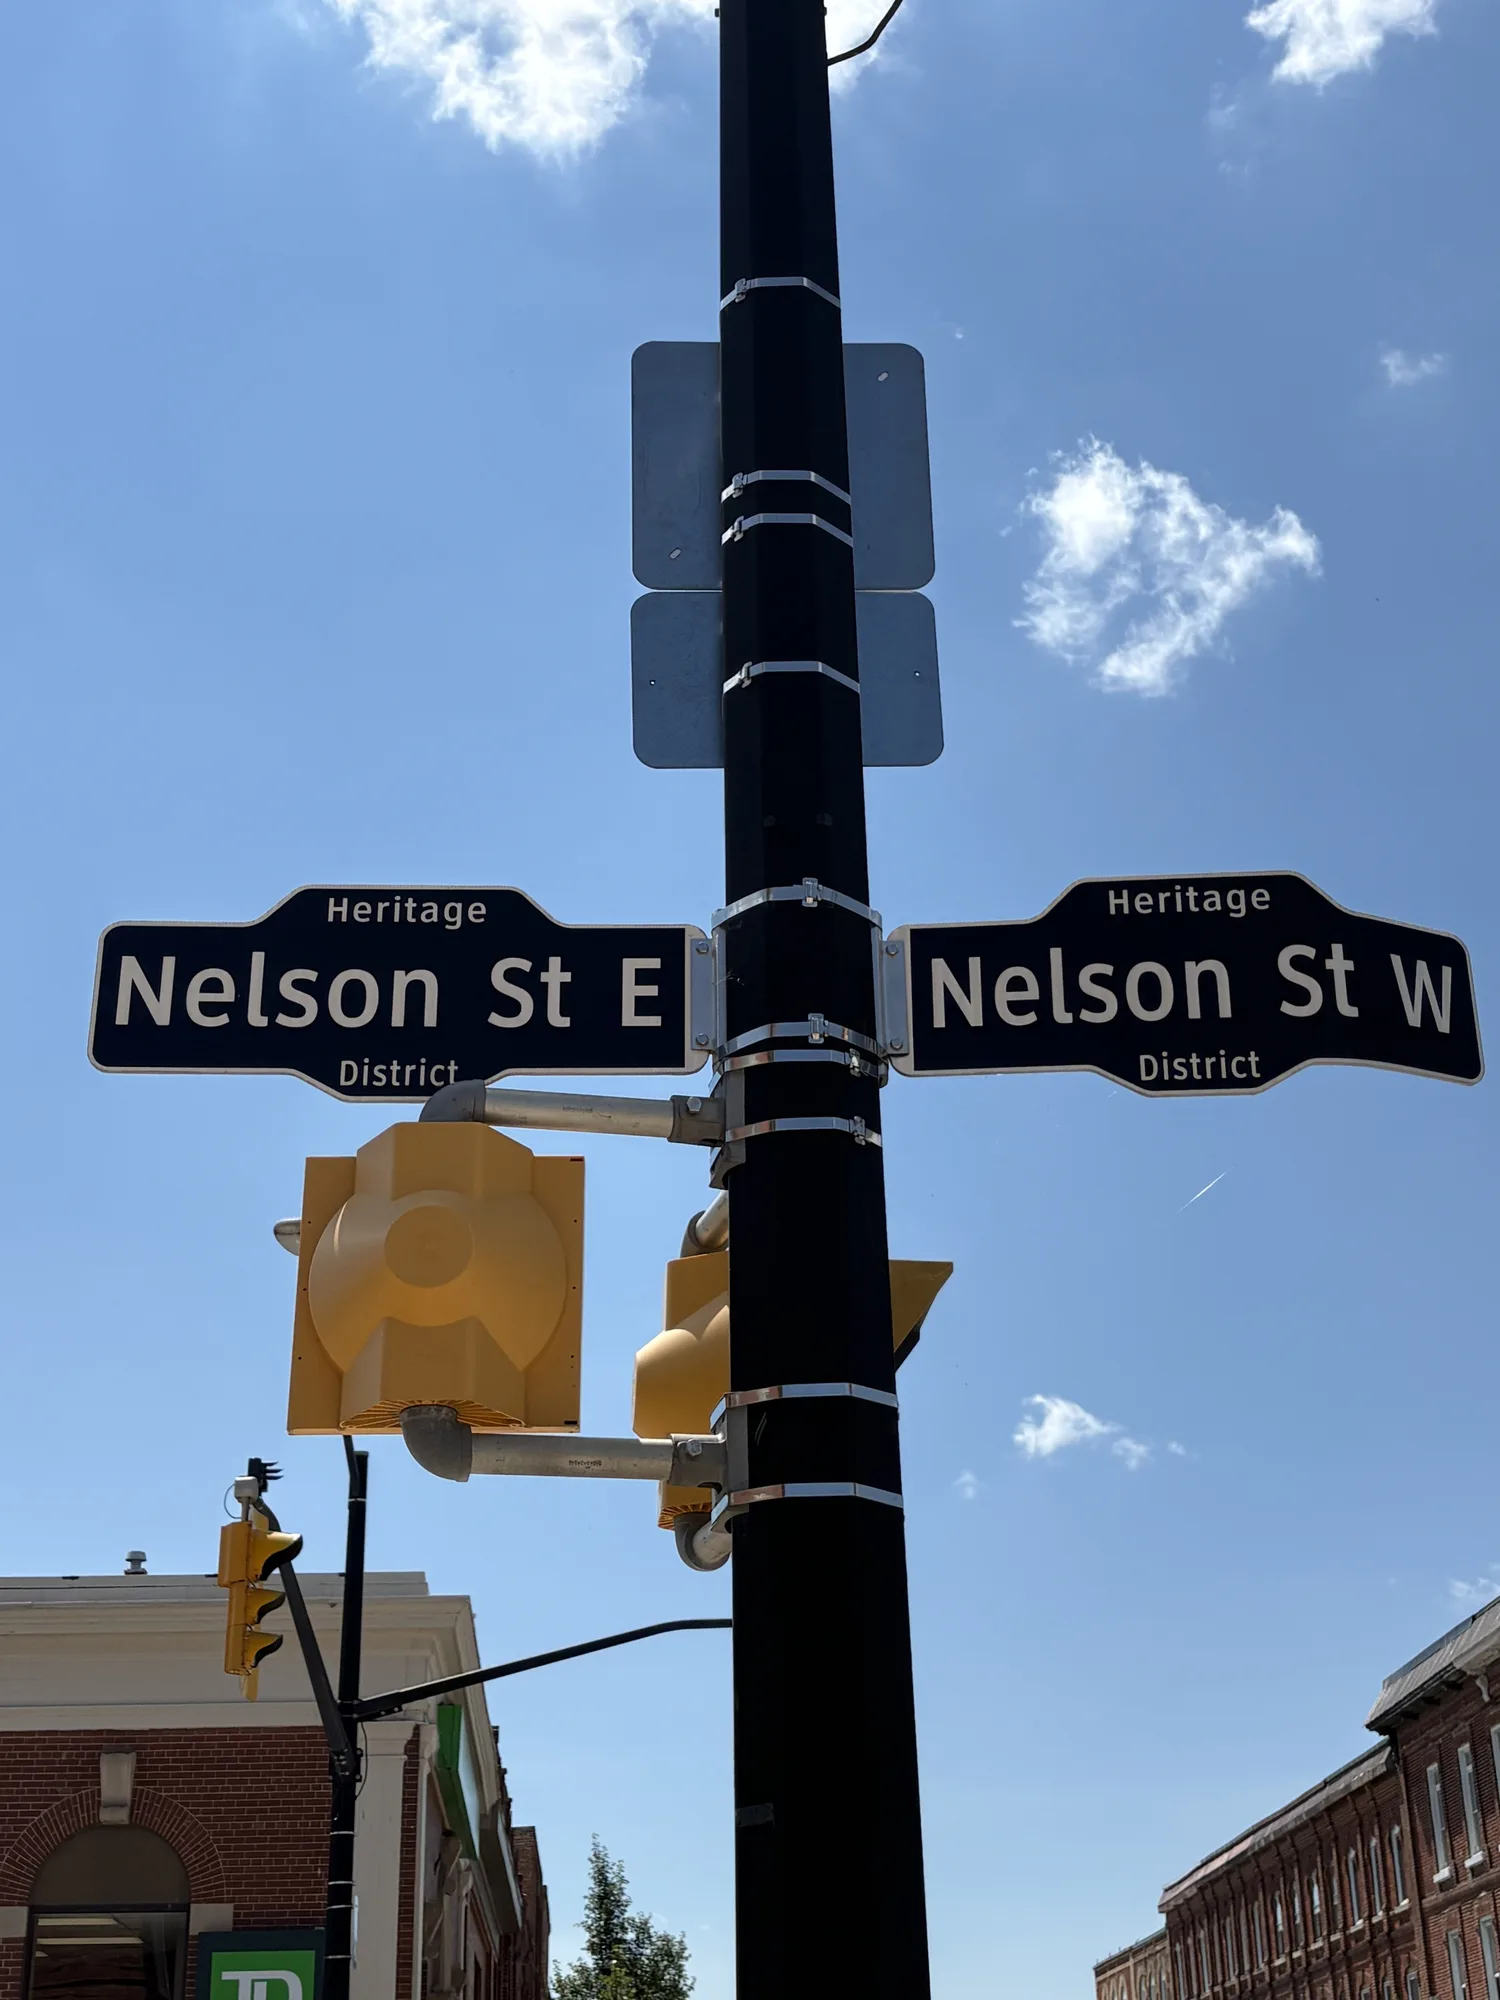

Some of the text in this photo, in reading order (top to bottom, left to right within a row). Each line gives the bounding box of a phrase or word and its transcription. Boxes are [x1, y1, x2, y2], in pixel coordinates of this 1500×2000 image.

[327, 895, 487, 930] Heritage
[1108, 884, 1271, 918] Heritage
[115, 951, 662, 1028] Nelson St E
[931, 943, 1453, 1034] Nelson St W
[339, 1057, 459, 1087] District
[1139, 1049, 1261, 1081] District
